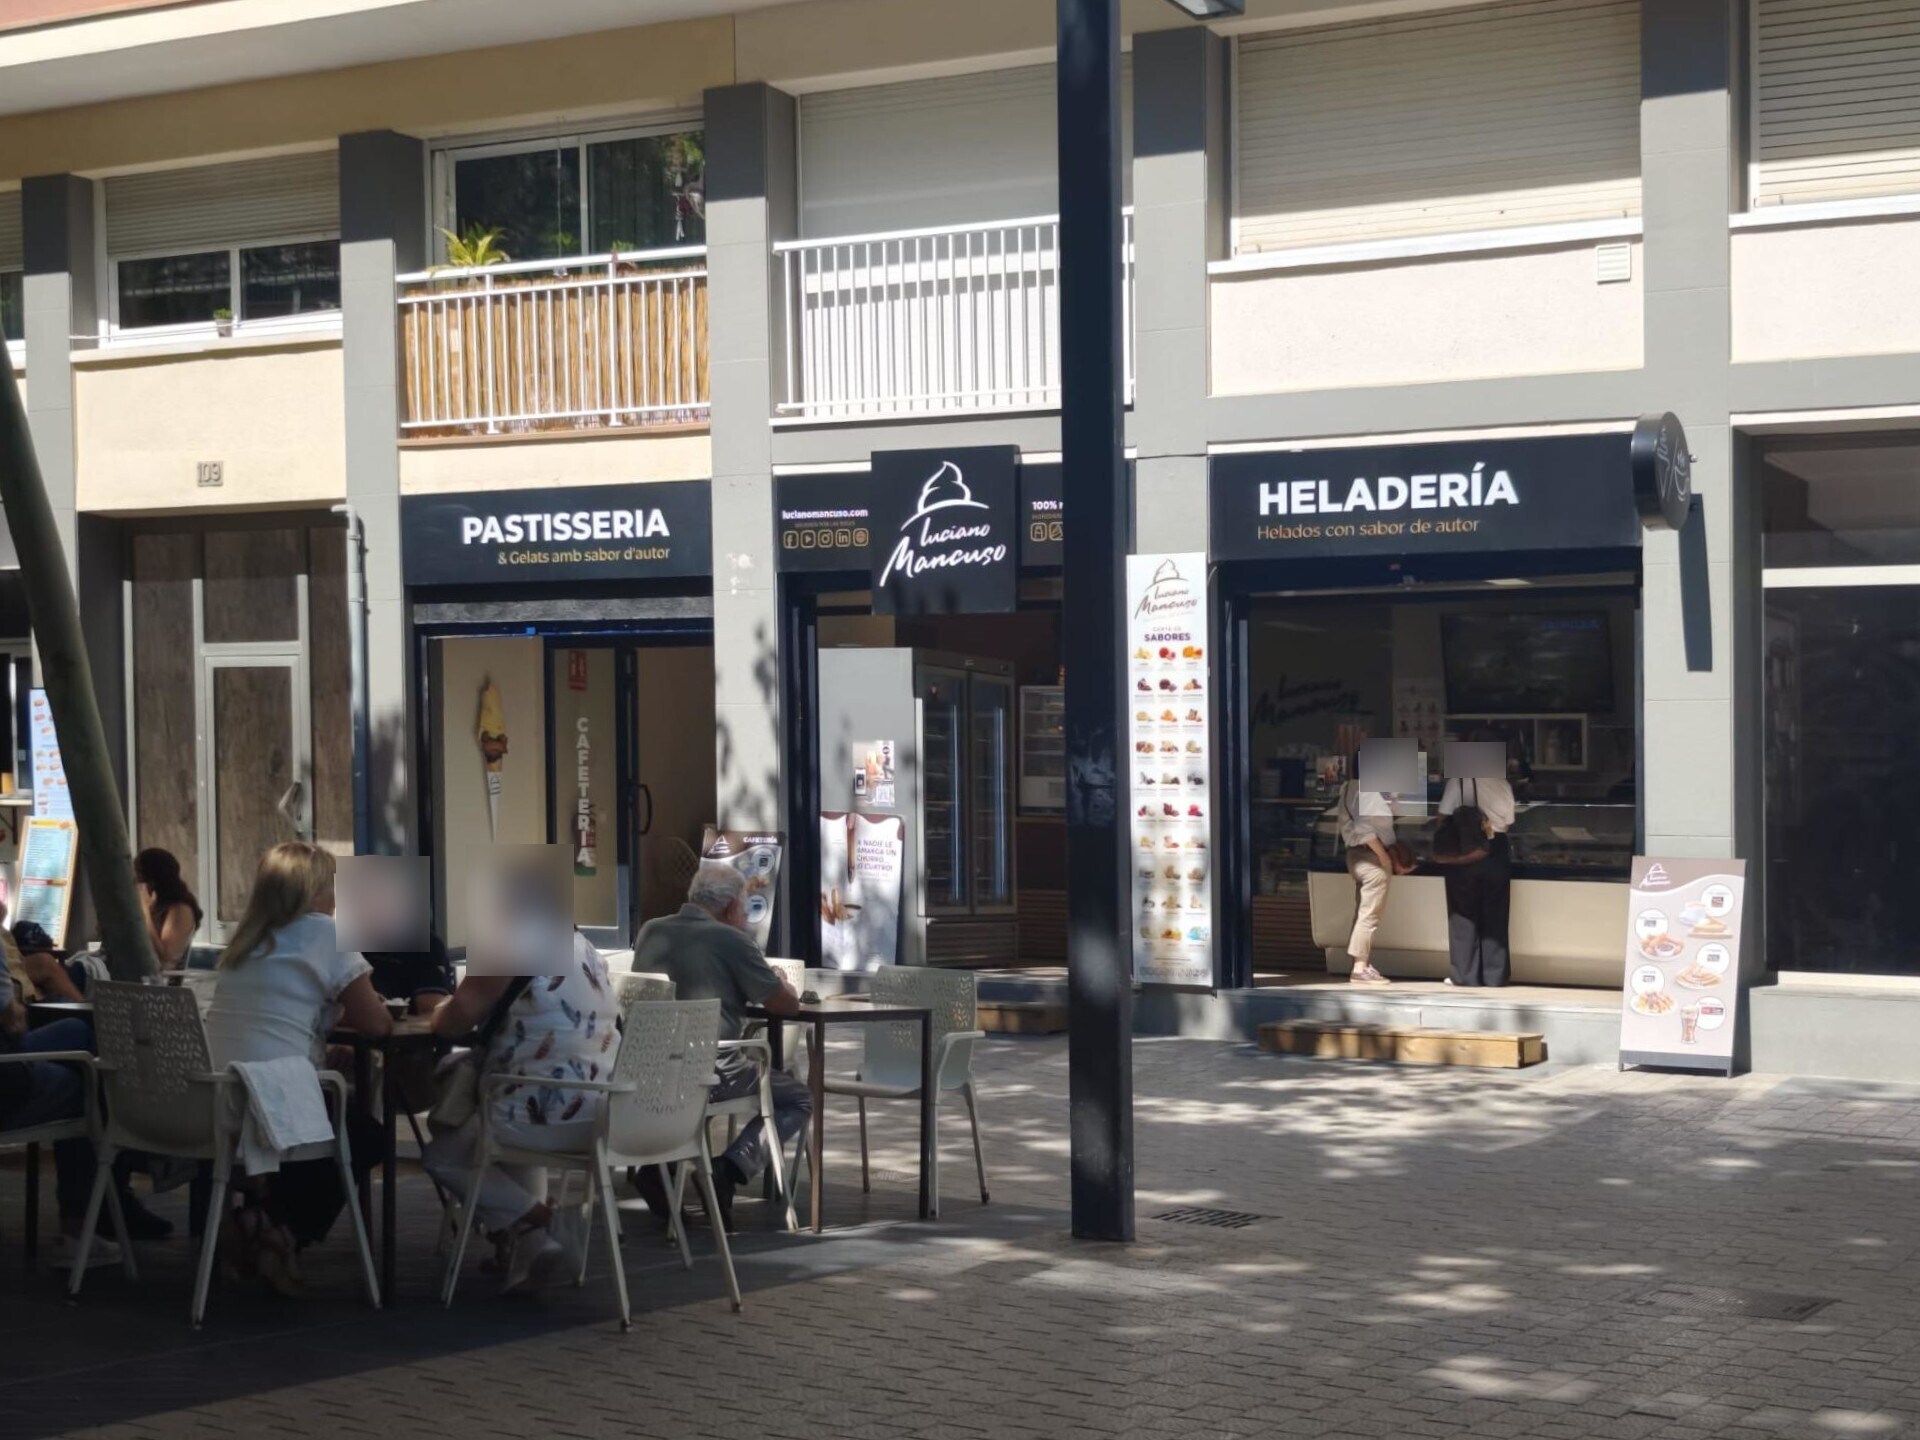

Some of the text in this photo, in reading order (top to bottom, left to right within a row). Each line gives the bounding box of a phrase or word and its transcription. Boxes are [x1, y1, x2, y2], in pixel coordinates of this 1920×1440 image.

[198, 462, 221, 483] 109
[1259, 461, 1519, 516] HELADERÍA
[782, 509, 868, 520] lucianomancuso.com
[1031, 500, 1058, 510] 100%
[462, 508, 671, 545] PASTISSERIA
[919, 516, 991, 547] Luciano
[1257, 518, 1480, 540] Helados con sabor de autor
[498, 546, 671, 565] & Gelats amb sabor d'autor
[879, 536, 1007, 587] Mancuso
[1134, 595, 1198, 620] Mancuso
[1144, 632, 1191, 642] SABORES
[576, 717, 591, 864] CAFETERIA
[857, 847, 897, 857] AMARGA UN
[863, 839, 883, 847] NADIE
[885, 840, 893, 848] LE
